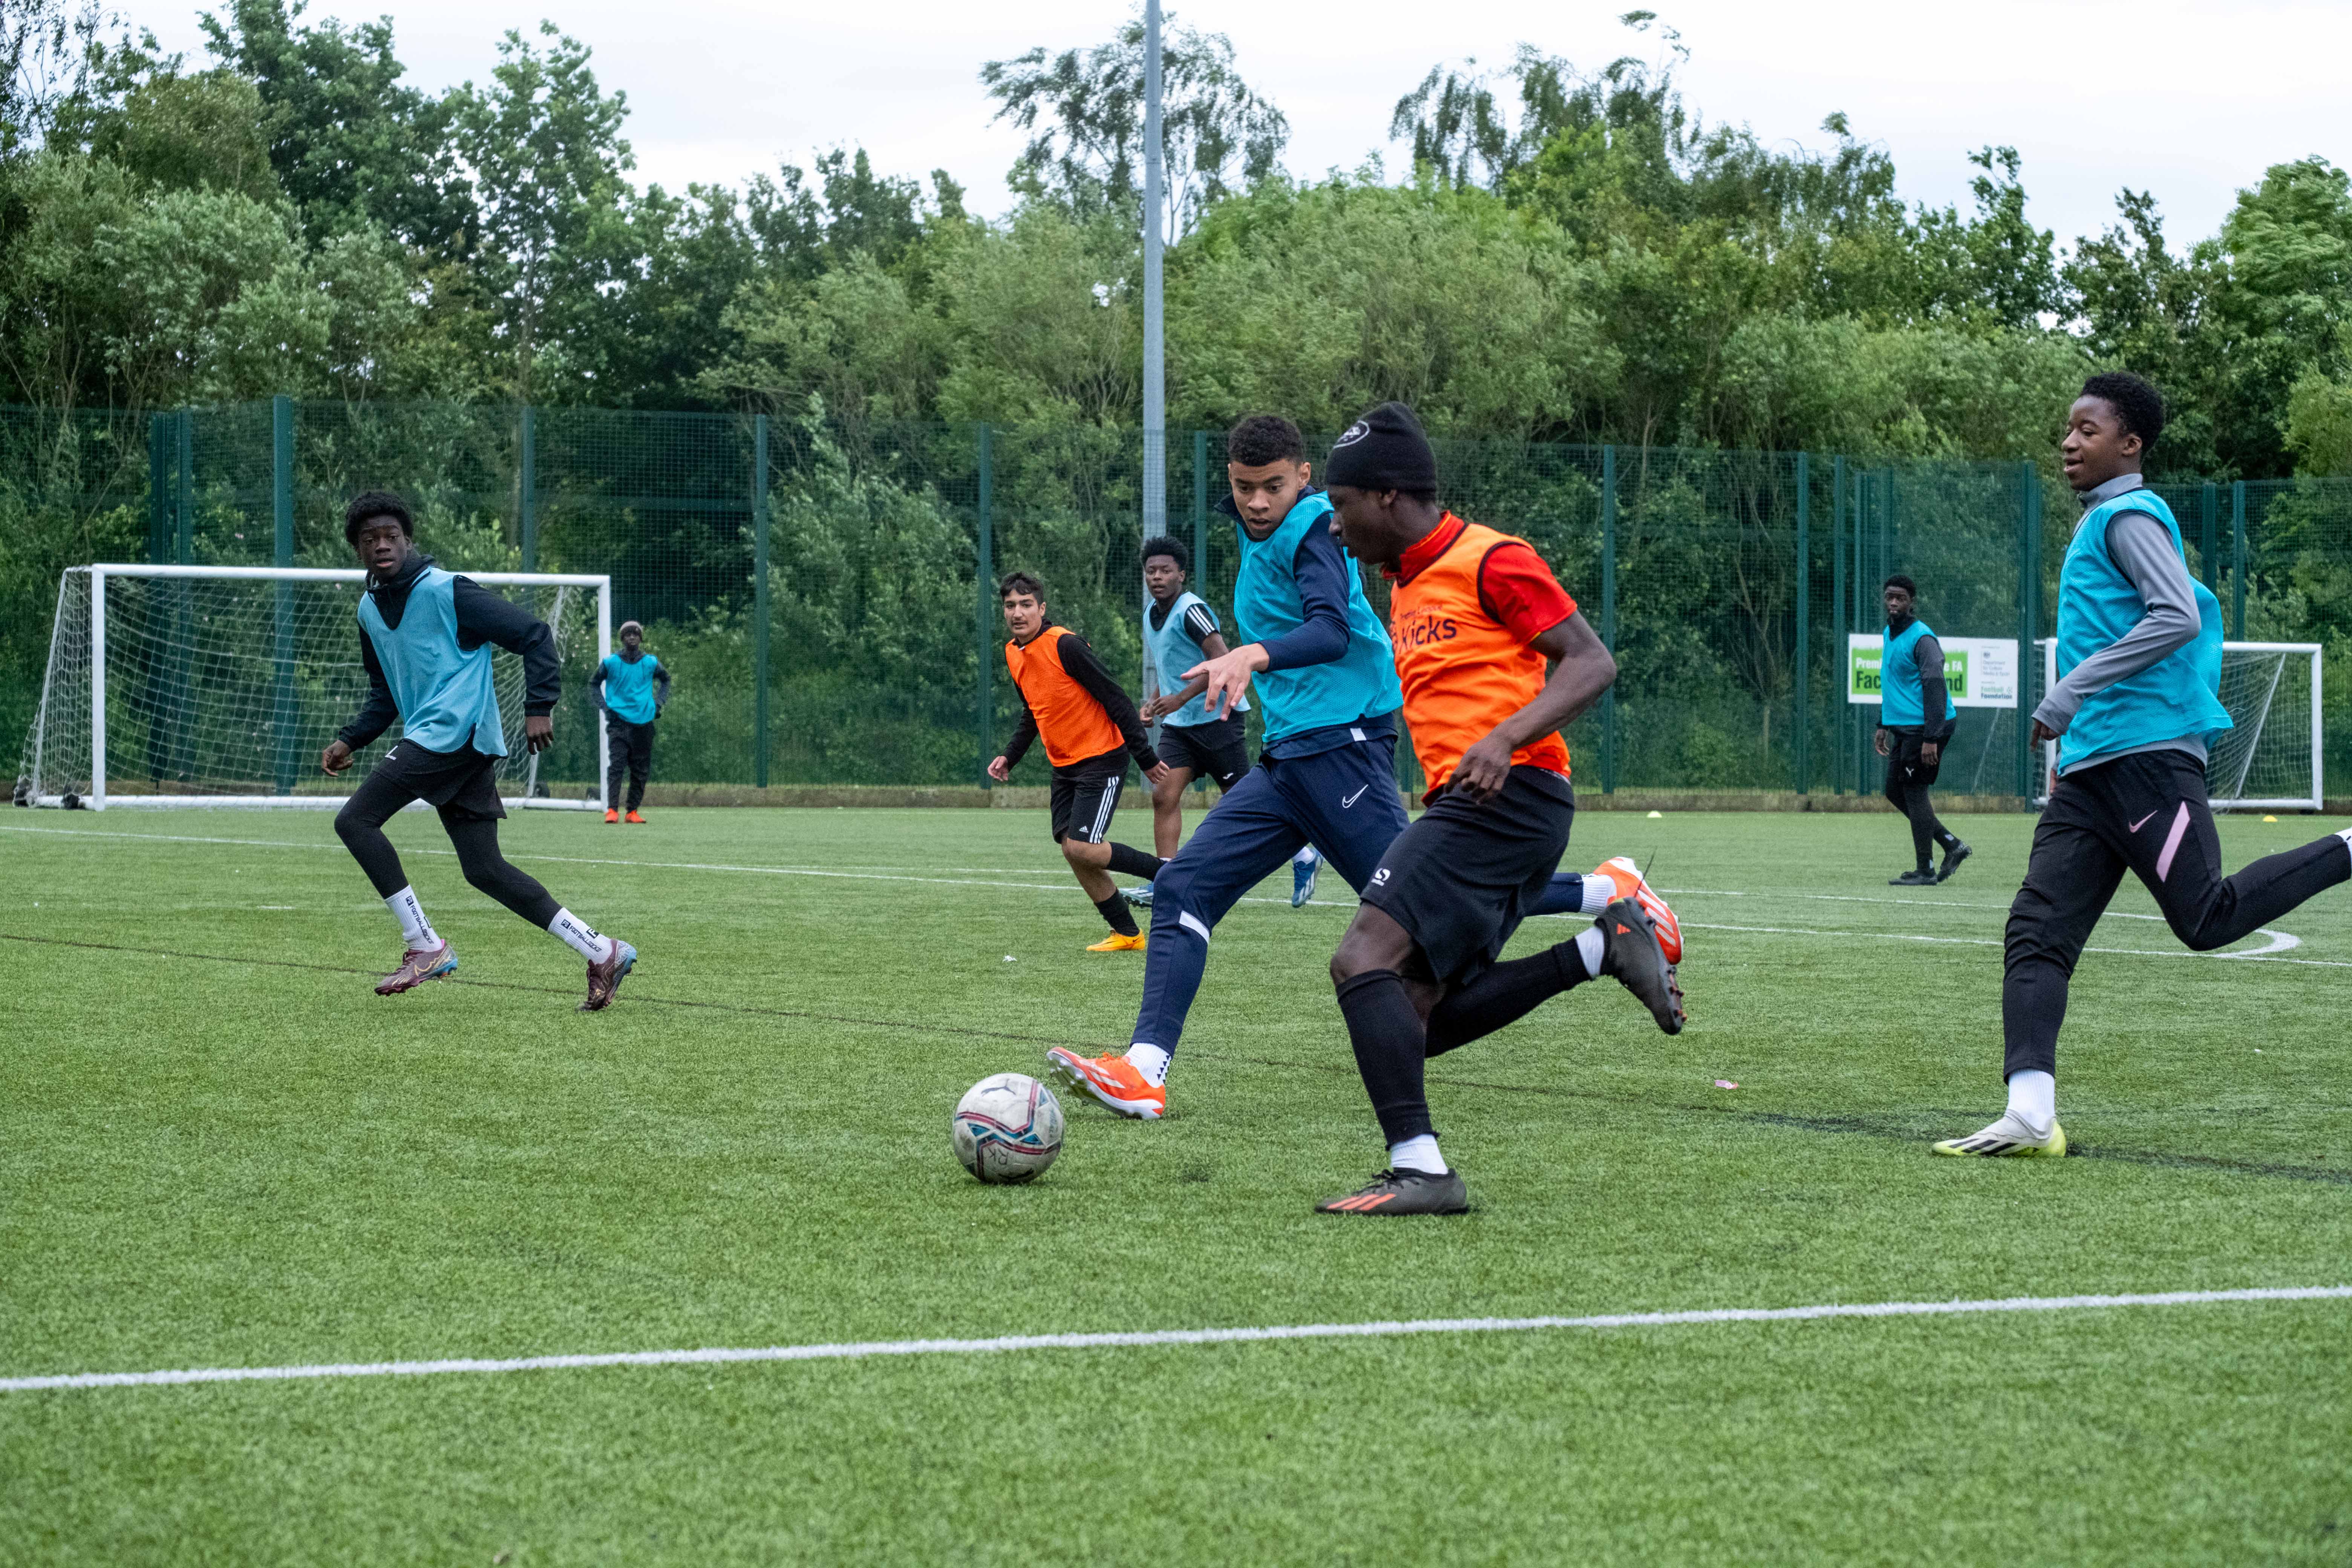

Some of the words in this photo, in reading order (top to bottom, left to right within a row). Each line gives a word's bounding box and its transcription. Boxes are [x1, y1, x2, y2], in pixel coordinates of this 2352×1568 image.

[1856, 657, 1882, 669] Premi
[1952, 661, 1963, 672] FA
[1856, 671, 1881, 689] Fac
[1946, 674, 1963, 691] nd
